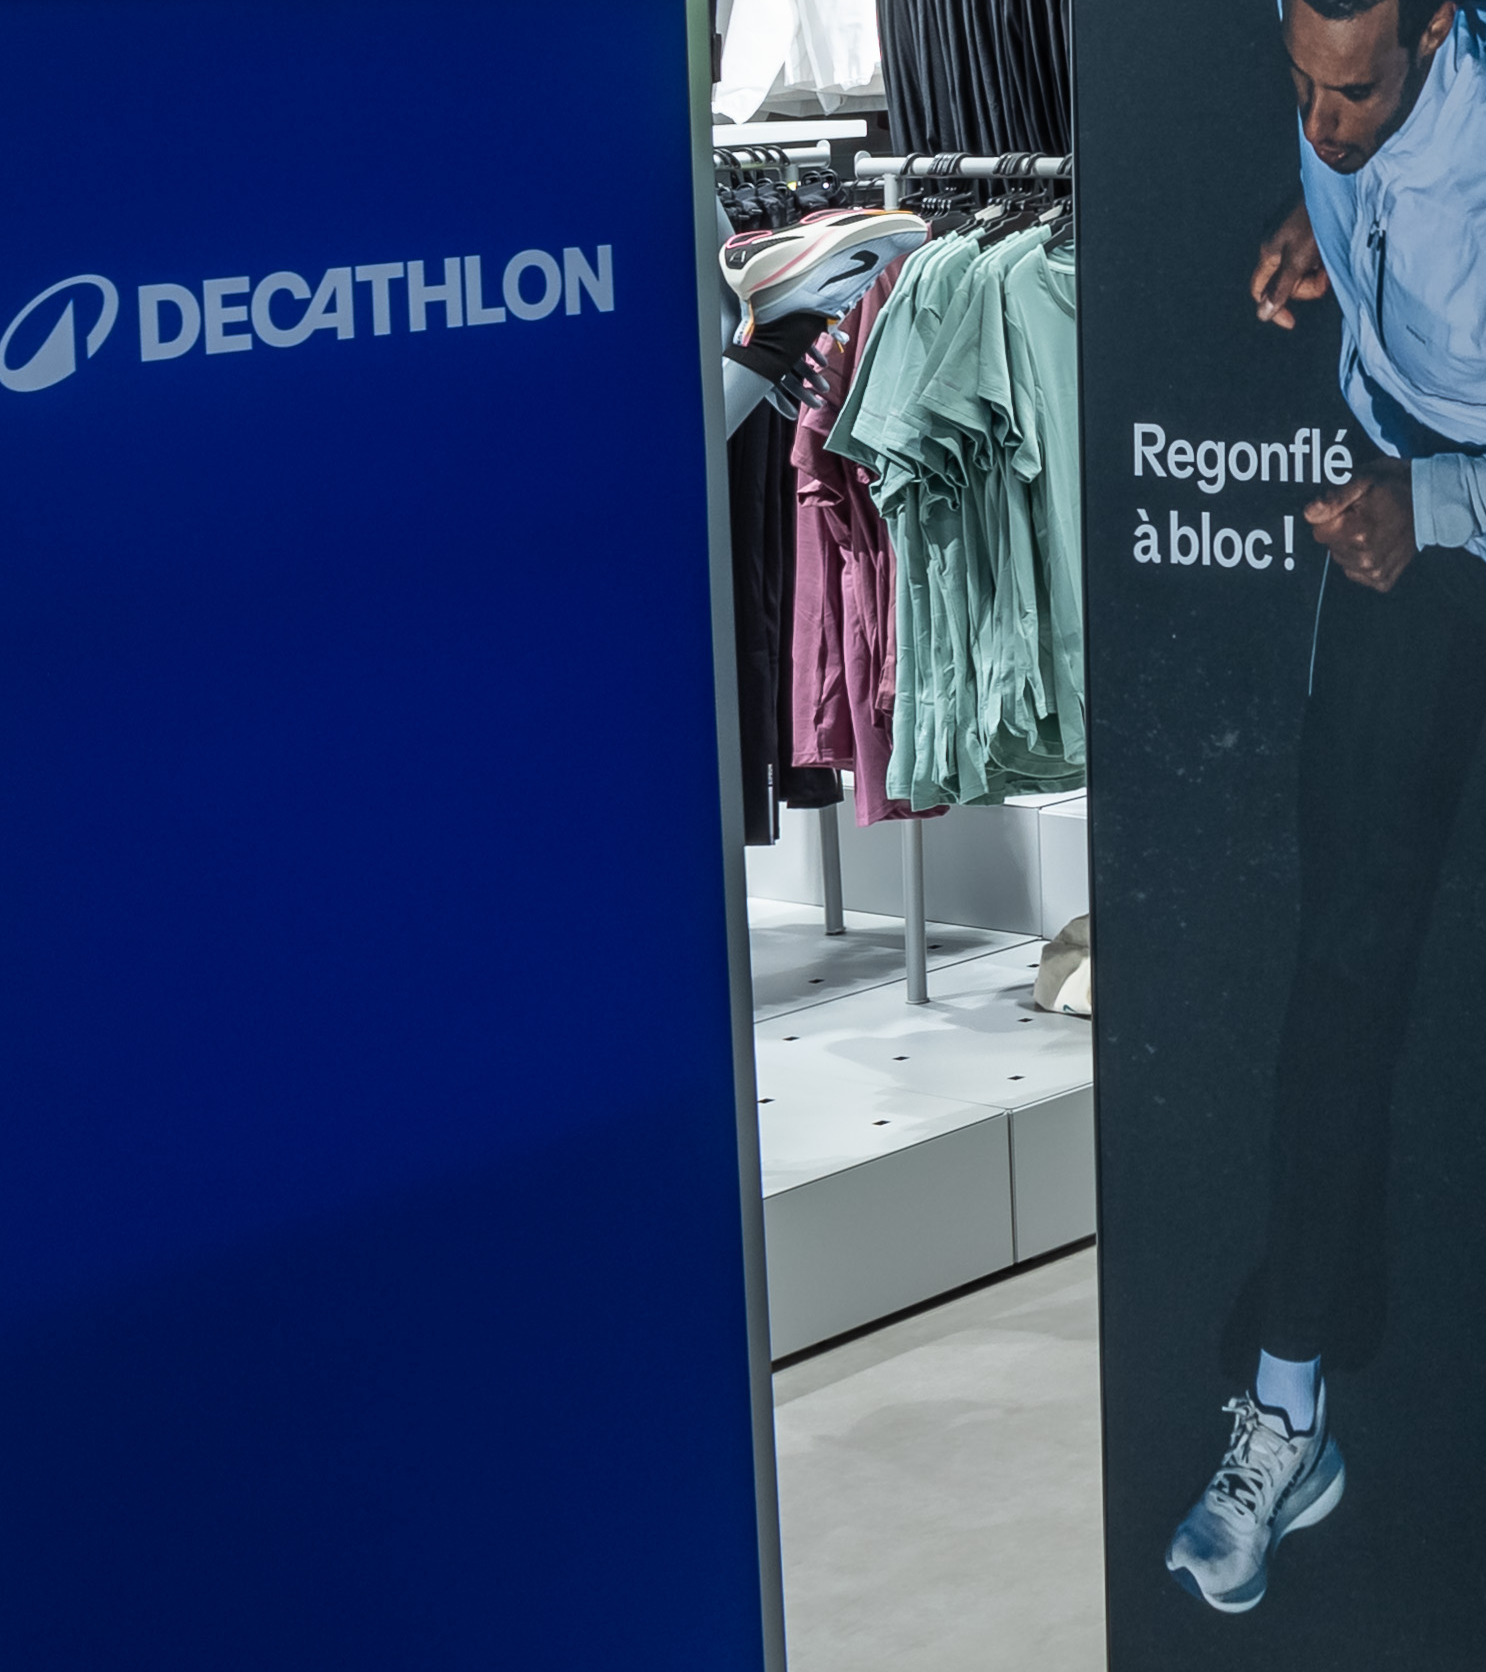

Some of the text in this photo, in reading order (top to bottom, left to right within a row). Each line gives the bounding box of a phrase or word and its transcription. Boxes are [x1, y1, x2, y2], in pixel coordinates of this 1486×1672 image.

[137, 244, 614, 362] DECATHLON
[1133, 422, 1353, 494] Regonflé
[1133, 509, 1161, 564] à
[1170, 510, 1273, 569] bloc
